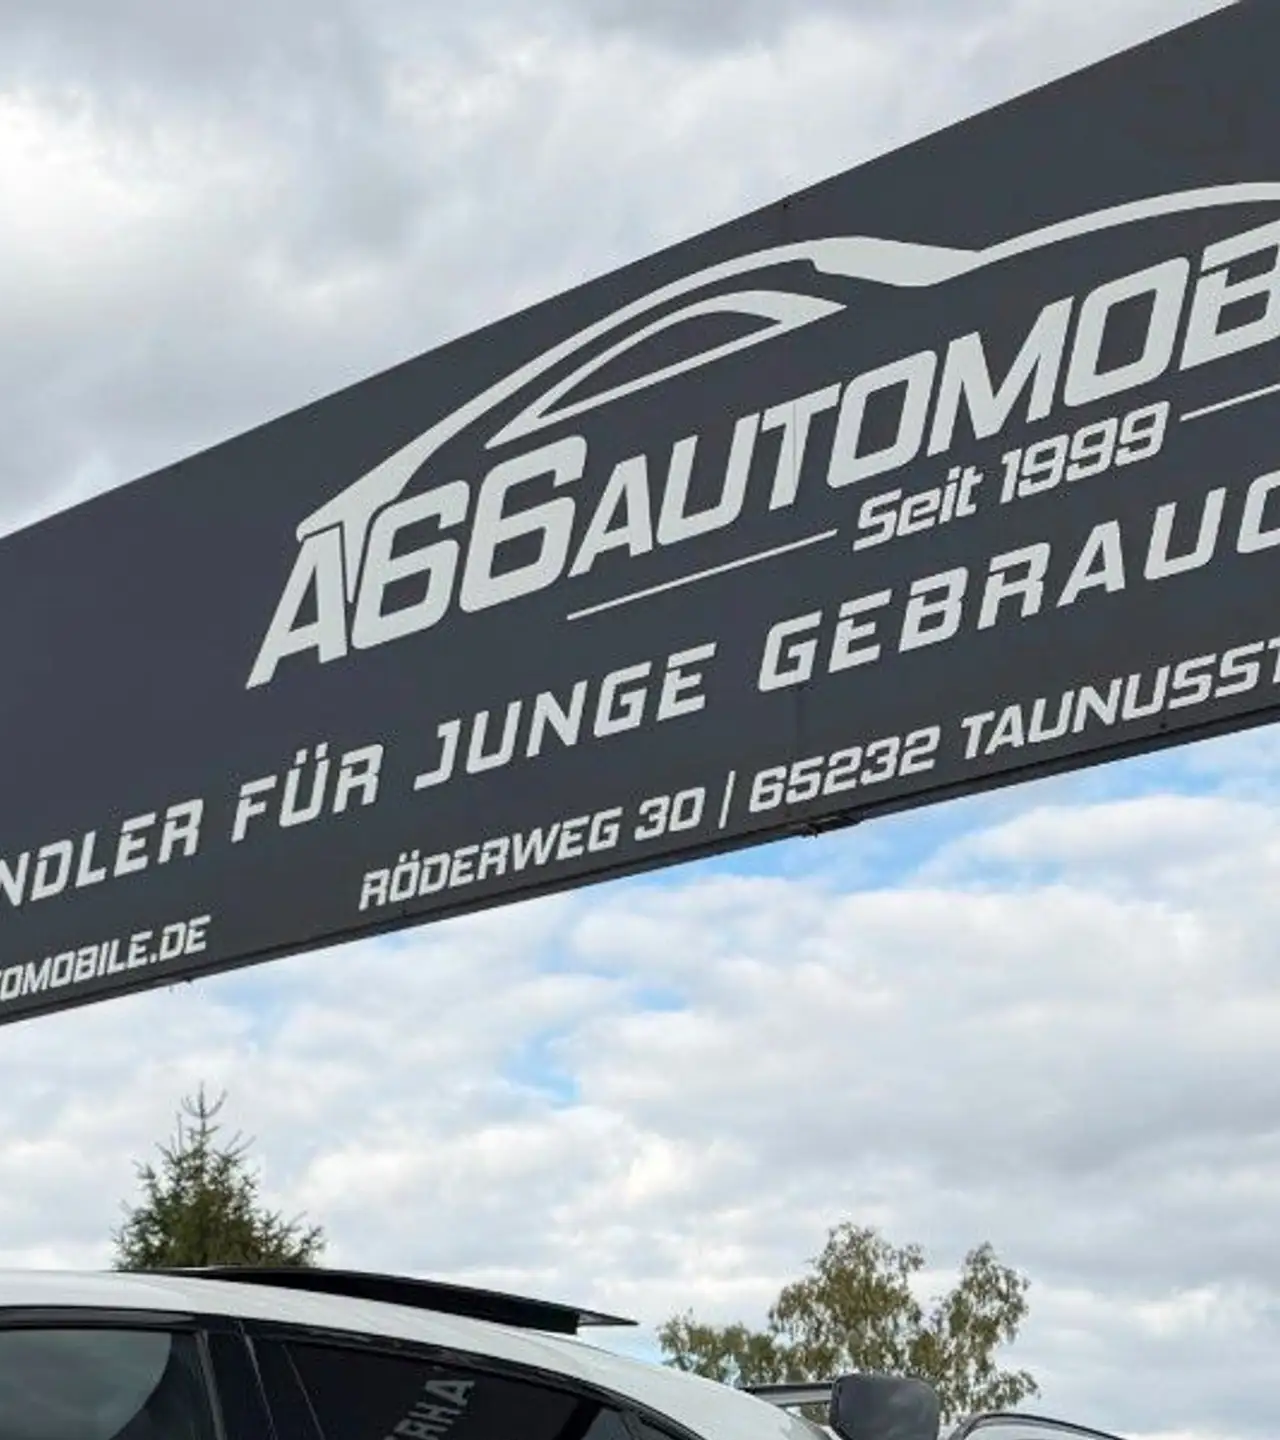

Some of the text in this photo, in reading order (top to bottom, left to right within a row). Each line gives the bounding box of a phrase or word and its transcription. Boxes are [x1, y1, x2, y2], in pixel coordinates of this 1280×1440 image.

[852, 401, 1170, 551] Seit 1999
[231, 742, 384, 843] FÜR
[414, 642, 717, 790] JUNGE
[359, 807, 622, 910] RÖDERWEG
[634, 787, 706, 842] 30
[749, 725, 940, 812] 65232
